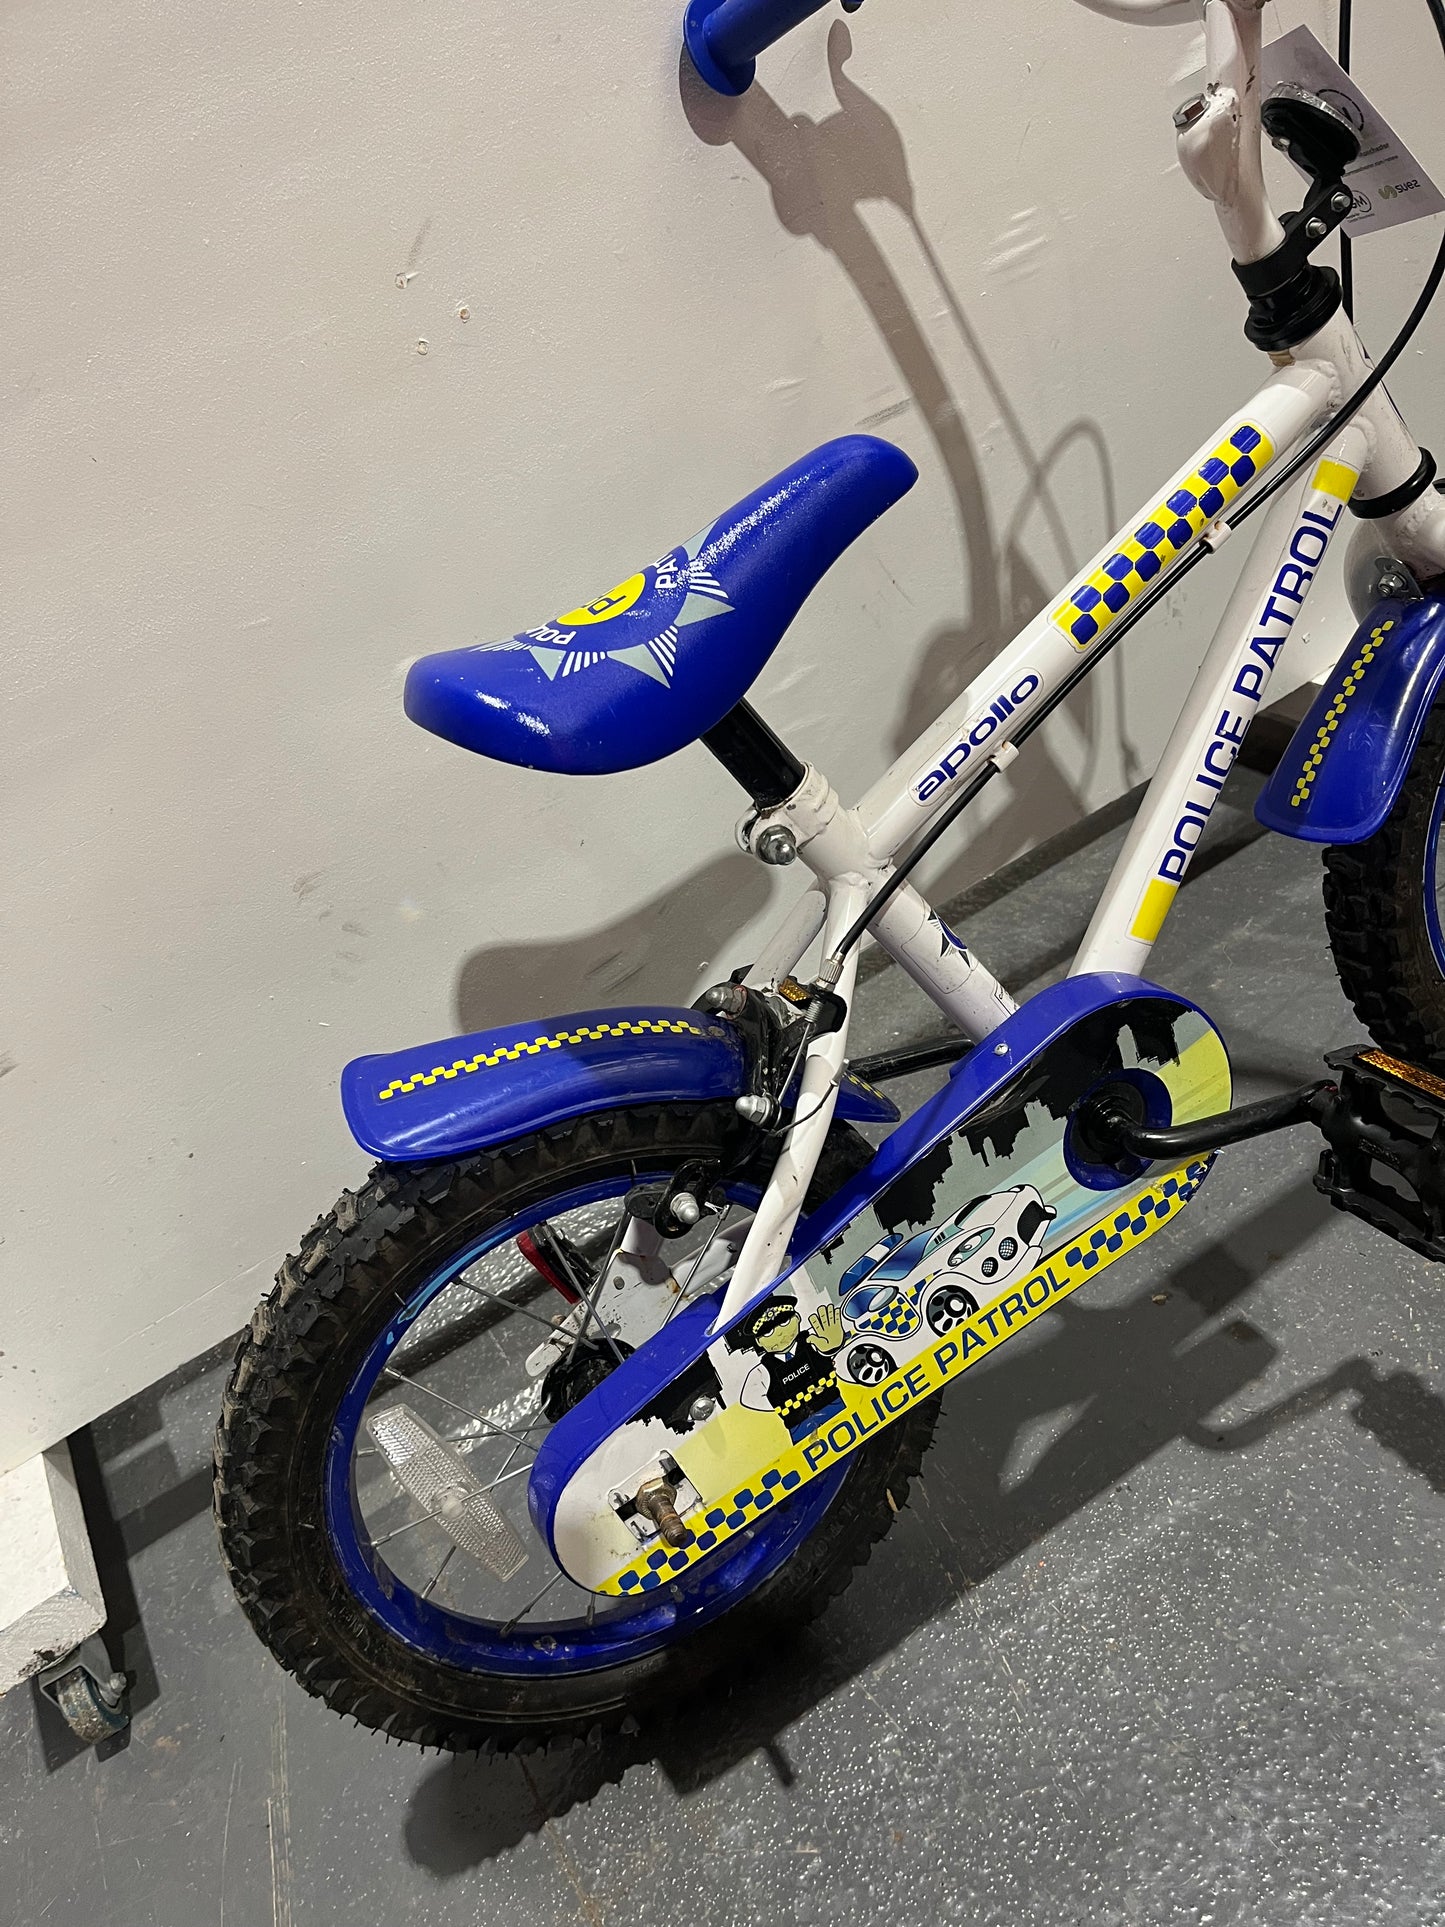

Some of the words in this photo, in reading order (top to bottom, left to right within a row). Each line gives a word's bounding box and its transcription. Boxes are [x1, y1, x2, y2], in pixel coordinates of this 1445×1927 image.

[918, 674, 1039, 801] apollo
[1157, 710, 1251, 882] POLICE
[1232, 503, 1343, 703] PATROL
[782, 1363, 810, 1385] POLICE
[801, 1363, 932, 1472] POLICE
[932, 1267, 1071, 1376] PATROL
